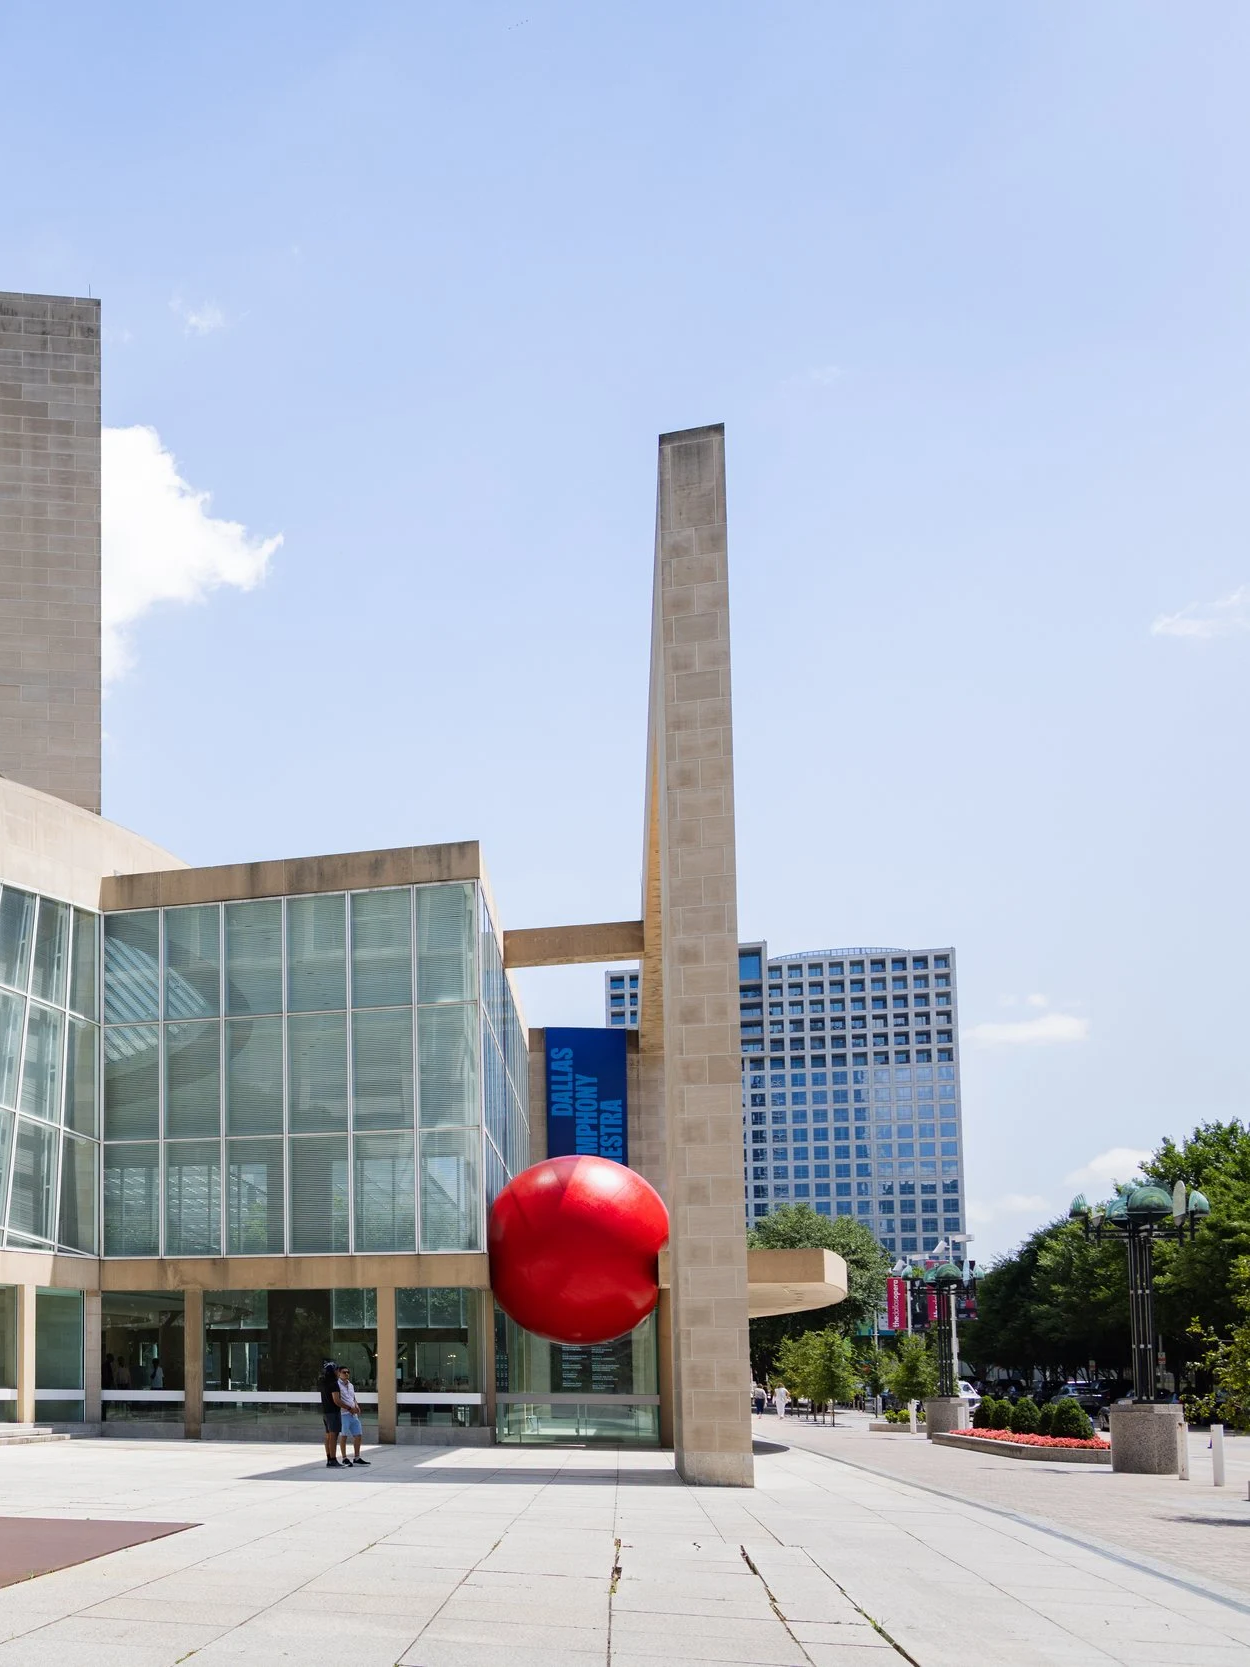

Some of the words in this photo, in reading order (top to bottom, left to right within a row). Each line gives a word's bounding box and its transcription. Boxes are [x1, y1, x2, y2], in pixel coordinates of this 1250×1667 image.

[551, 1048, 573, 1116] DALLAS
[575, 1074, 598, 1155] MPHONY
[600, 1100, 622, 1163] ESTRA
